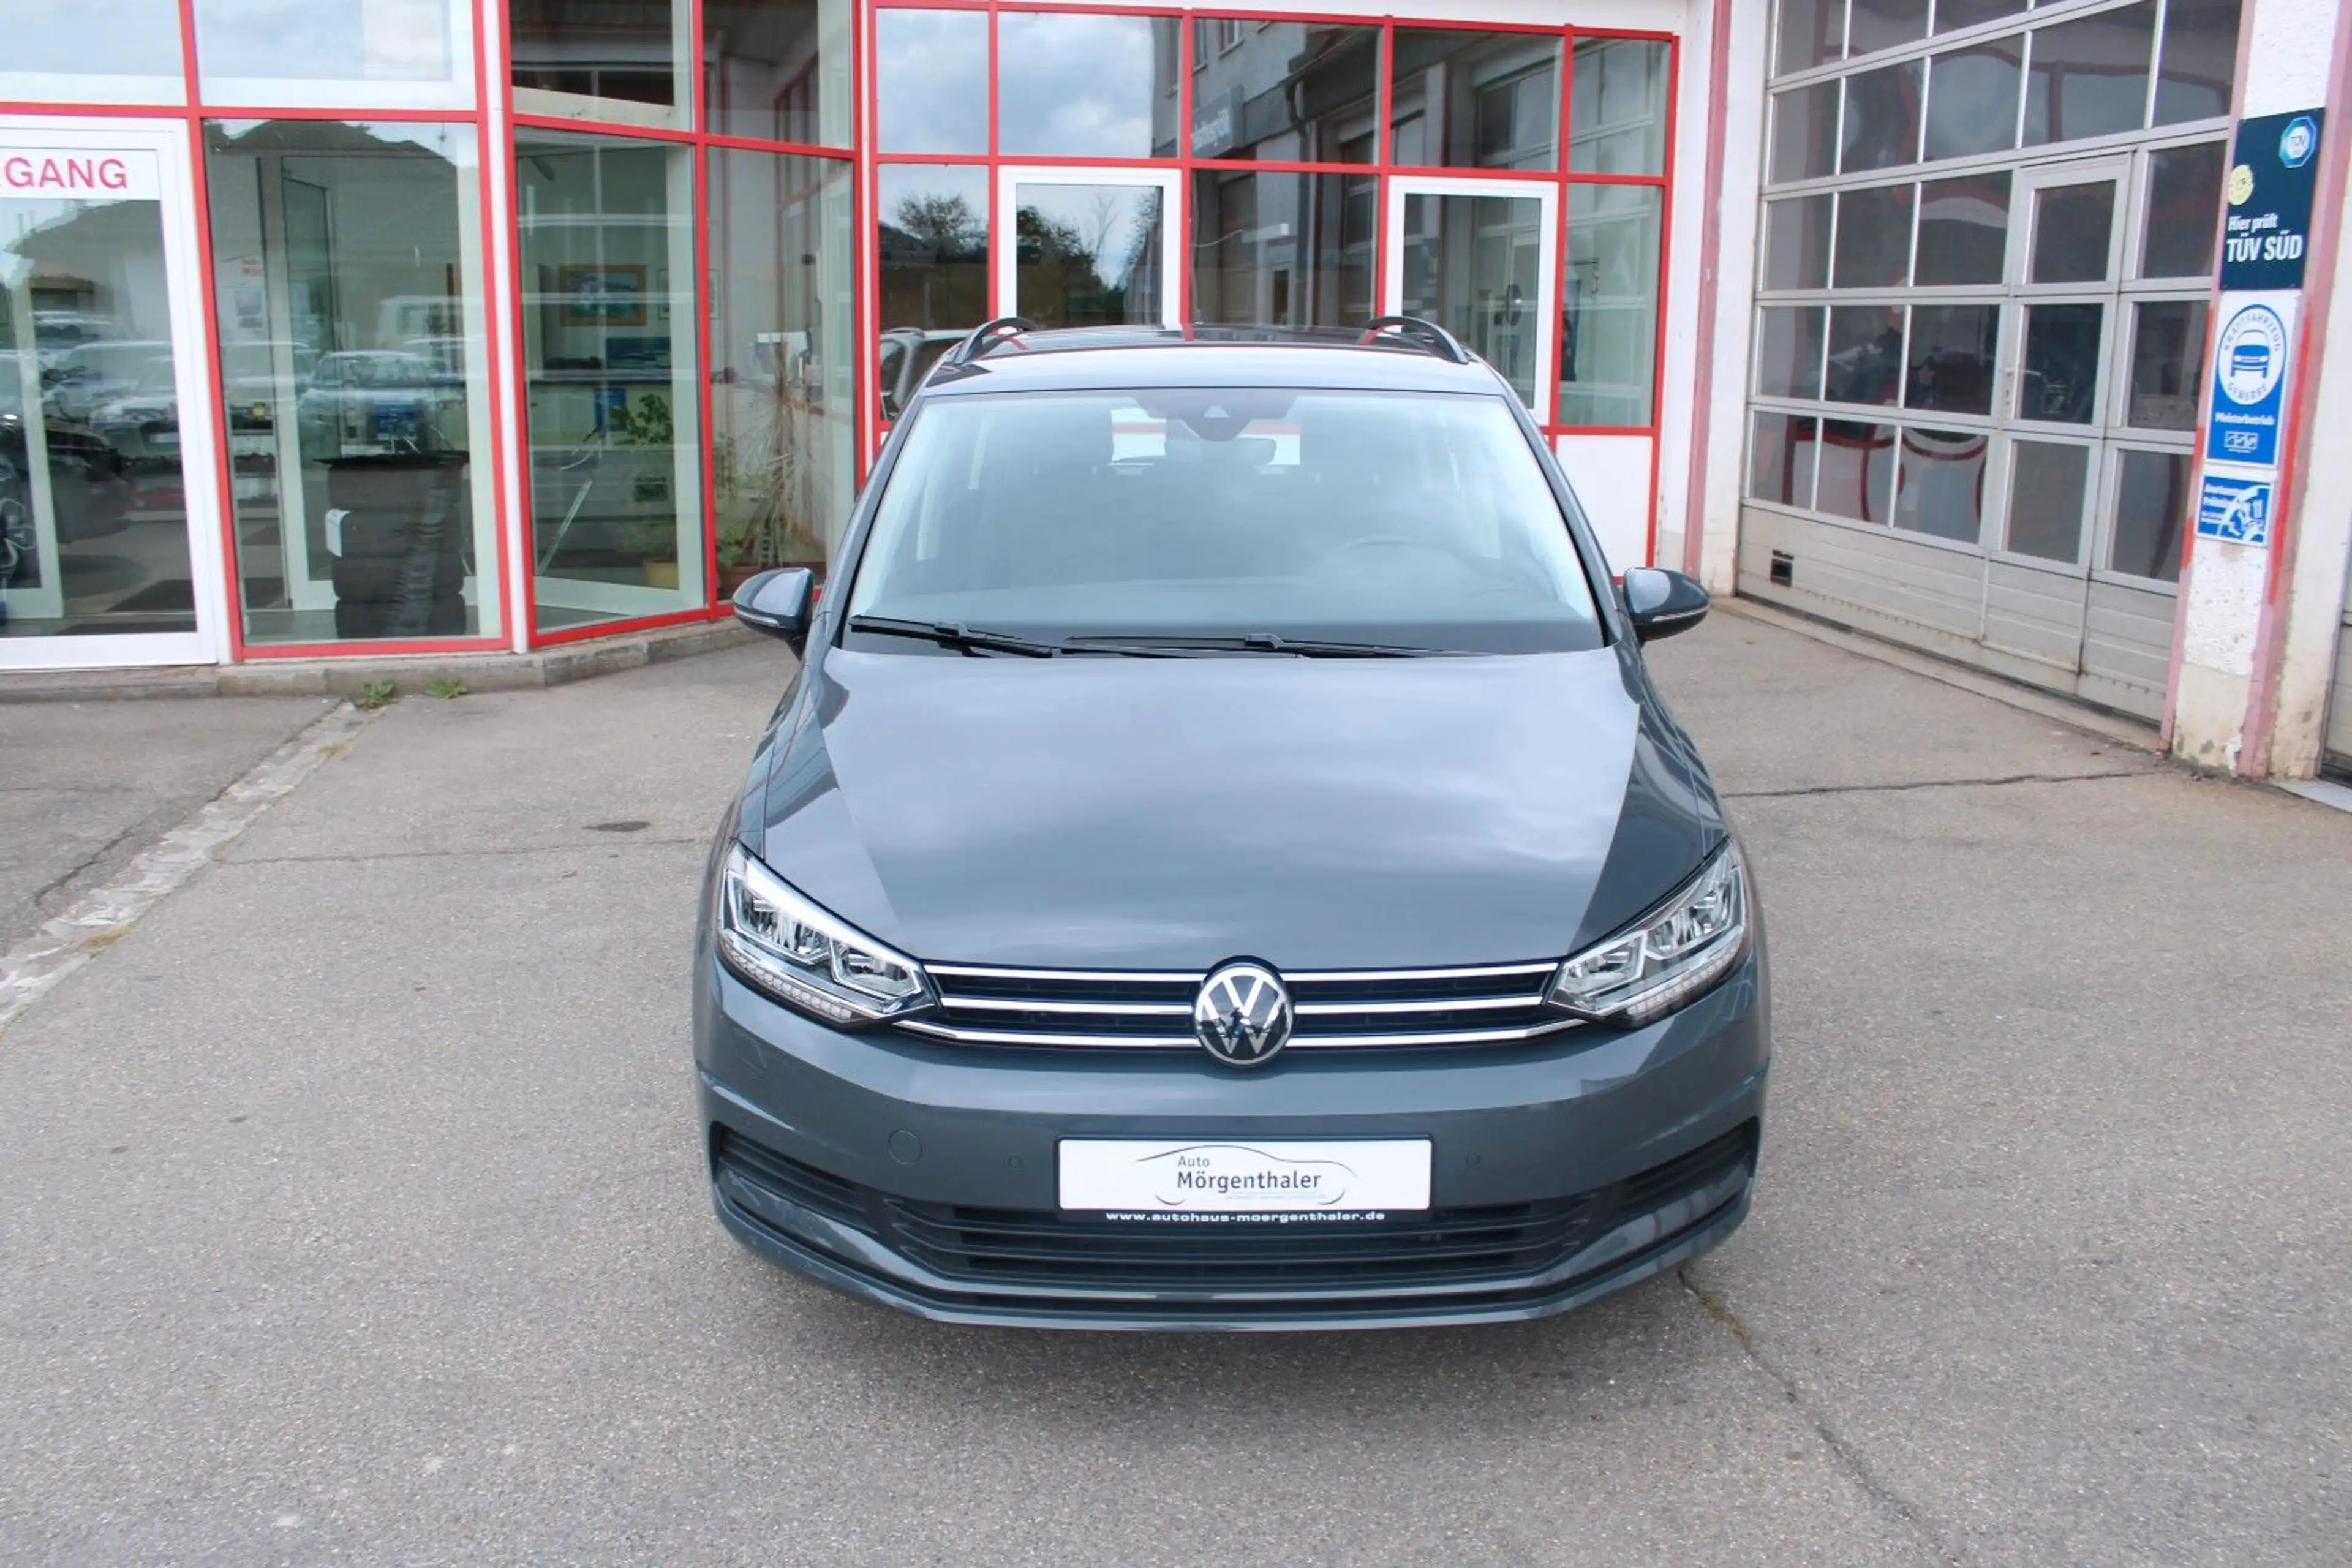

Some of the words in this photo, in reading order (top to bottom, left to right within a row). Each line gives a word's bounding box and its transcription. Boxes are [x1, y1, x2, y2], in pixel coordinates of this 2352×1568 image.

[2228, 216, 2251, 231] Hier
[2251, 213, 2278, 233] prüft
[2226, 232, 2263, 262] TÜV
[2264, 229, 2303, 261] SÜD
[1178, 1155, 1210, 1167] Auto
[1177, 1171, 1321, 1194] Mörgenthaler
[1105, 1210, 1385, 1224] www.autohaus-moergenthaler.de
